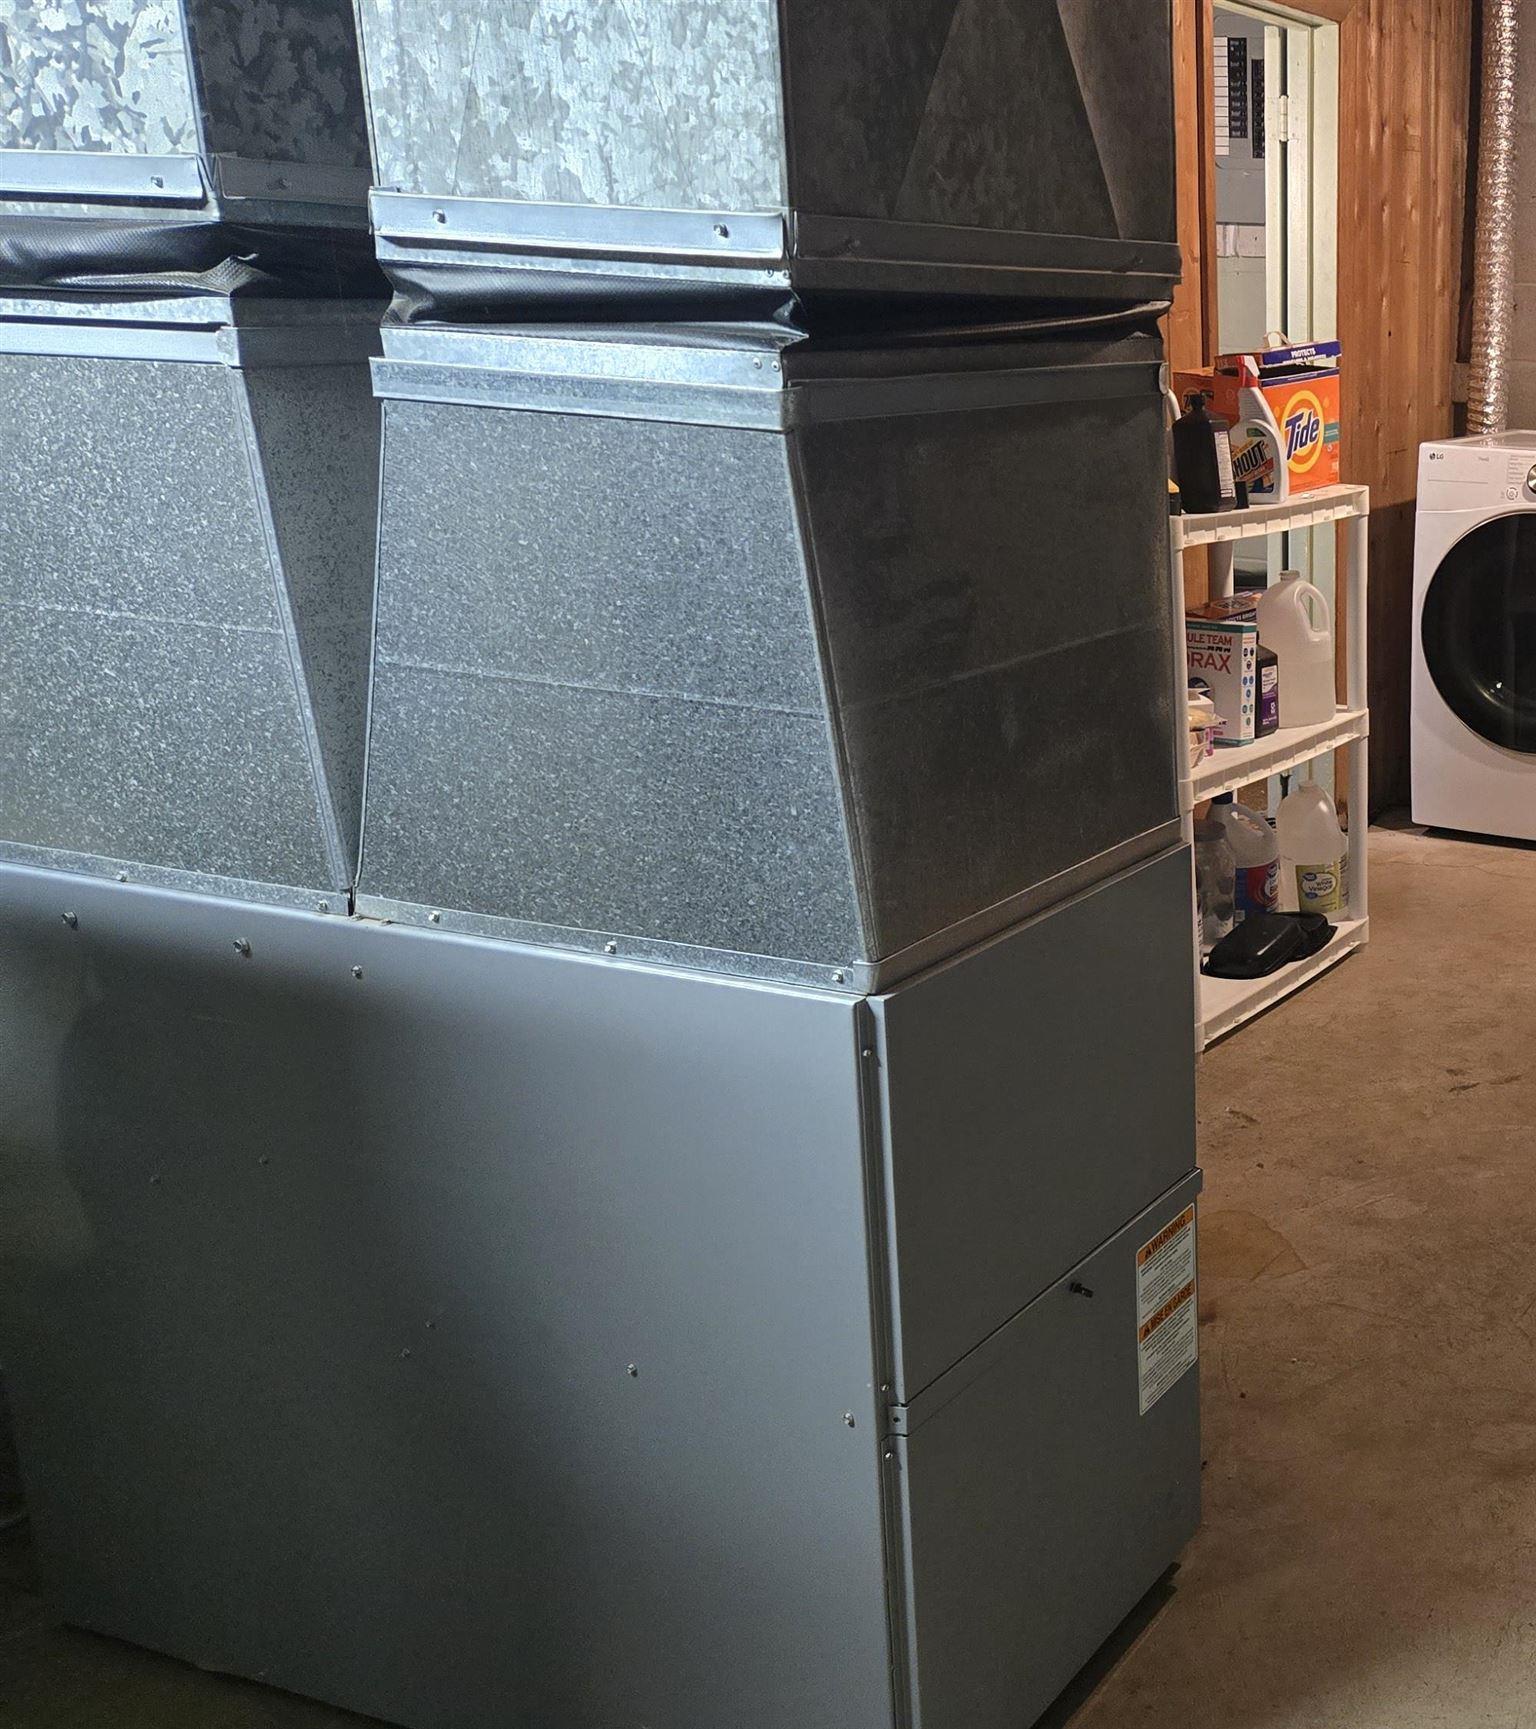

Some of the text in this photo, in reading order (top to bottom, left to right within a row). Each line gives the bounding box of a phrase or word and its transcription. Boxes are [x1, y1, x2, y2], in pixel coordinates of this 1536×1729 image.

[1291, 347, 1316, 359] PROTECTS
[1285, 411, 1320, 460] Tide
[1231, 440, 1266, 479] HOUT
[1187, 633, 1205, 644] ULE
[1207, 634, 1232, 646] TEAM
[1151, 1216, 1186, 1251] WARNING
